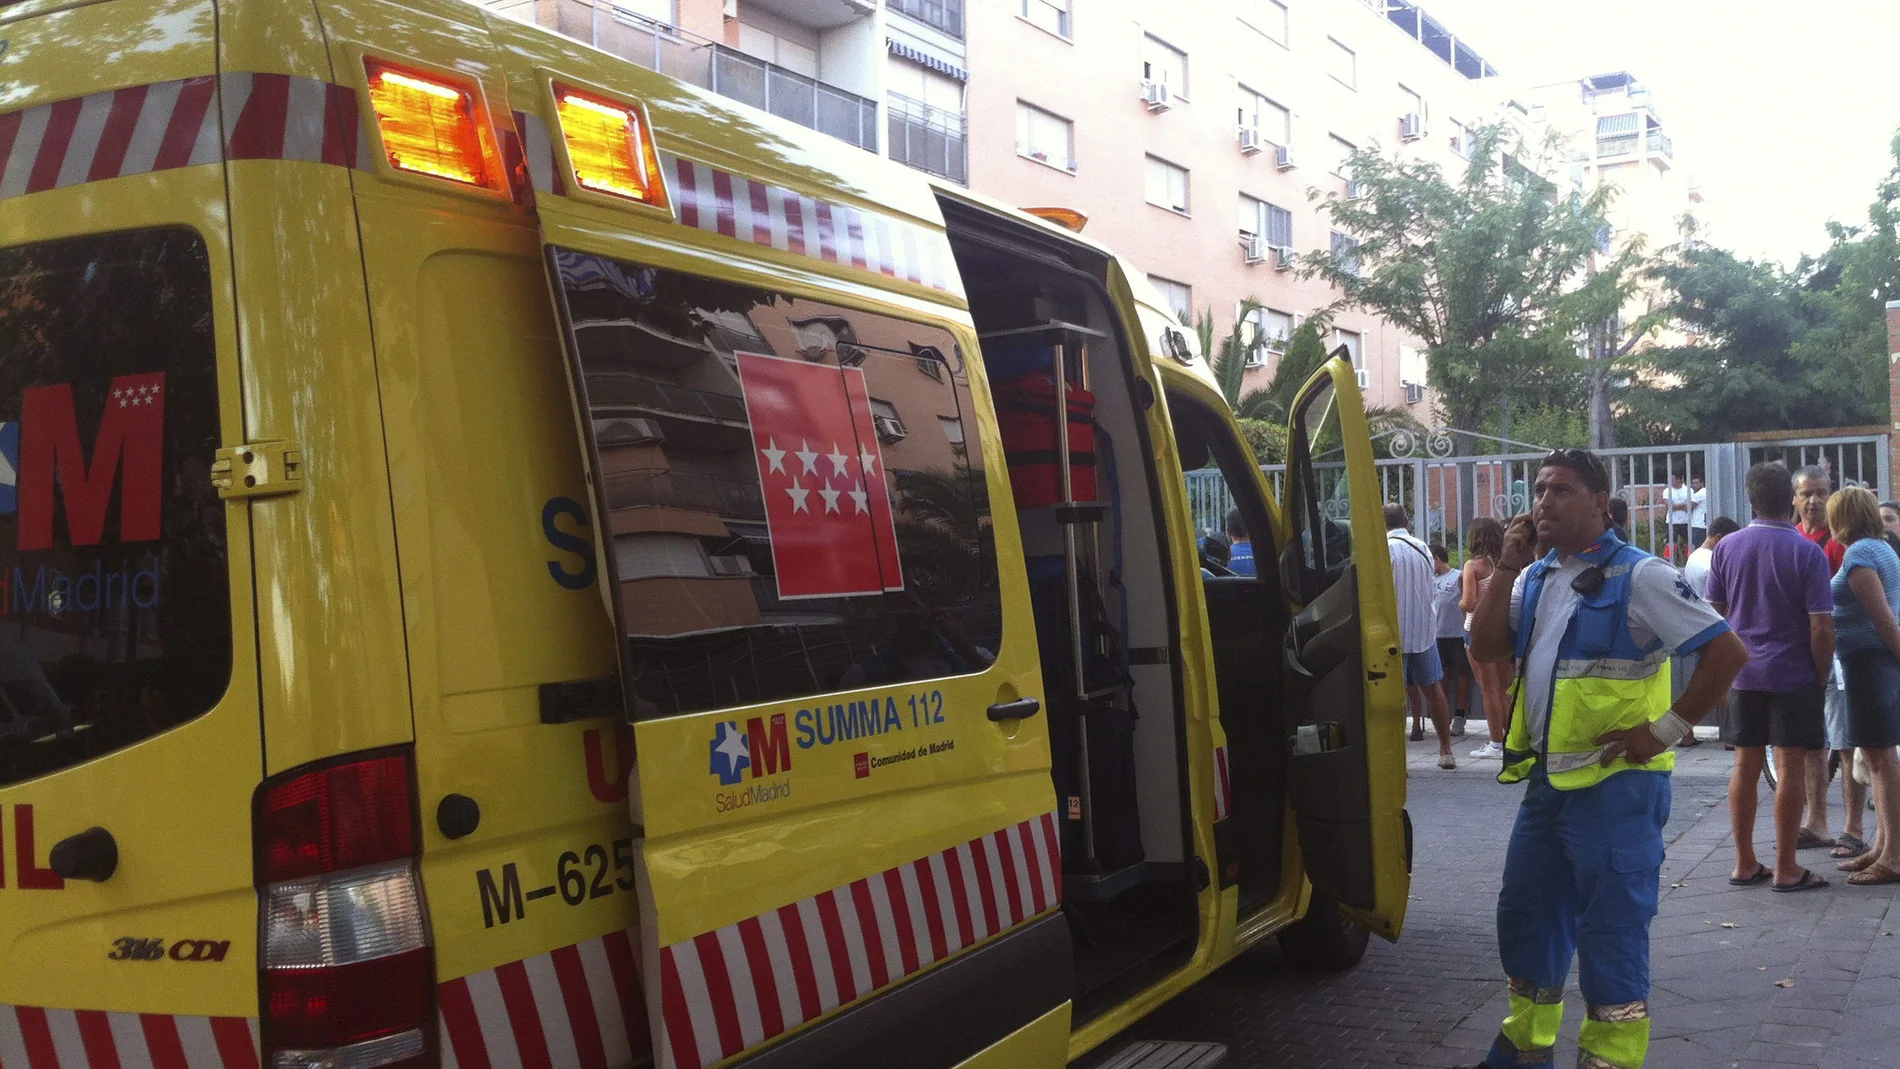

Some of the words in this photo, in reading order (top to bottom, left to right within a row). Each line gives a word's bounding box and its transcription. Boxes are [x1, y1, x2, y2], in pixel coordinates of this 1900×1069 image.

[795, 697, 902, 749] SUMMA
[908, 690, 945, 728] 112
[870, 747, 916, 768] Comunidad
[918, 746, 928, 757] de
[929, 739, 955, 755] Madrid
[0, 804, 65, 890] L
[108, 936, 165, 961] 316
[168, 939, 231, 962] CDI
